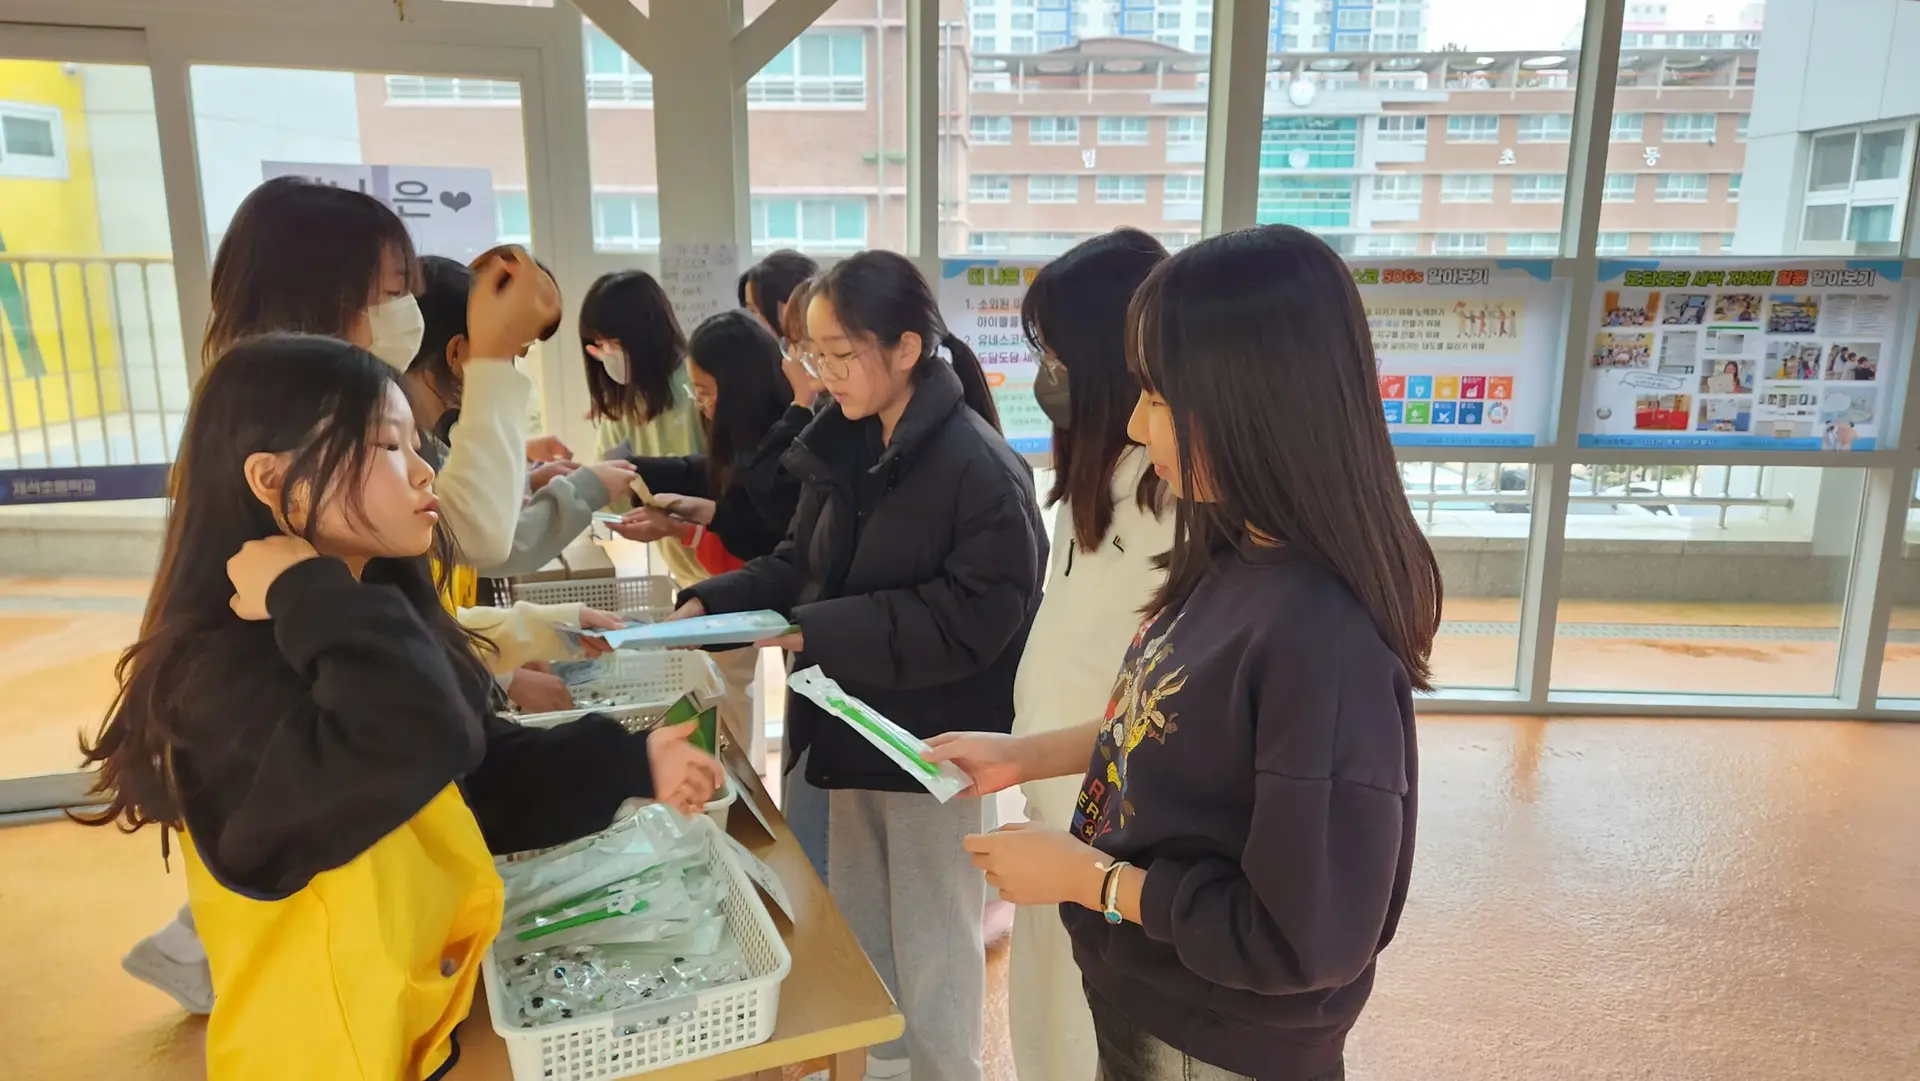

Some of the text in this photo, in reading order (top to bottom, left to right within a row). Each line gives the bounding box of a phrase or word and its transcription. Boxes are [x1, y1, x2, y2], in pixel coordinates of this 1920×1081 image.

[1498, 149, 1516, 165] 초
[1643, 147, 1660, 166] 등
[968, 268, 984, 286] 더
[988, 268, 1020, 286] 나은
[1382, 268, 1424, 283] SDGs
[1427, 267, 1489, 285] 알아보기
[1623, 269, 1876, 287] 도담도담 새싹 자치회 활동 알아보기
